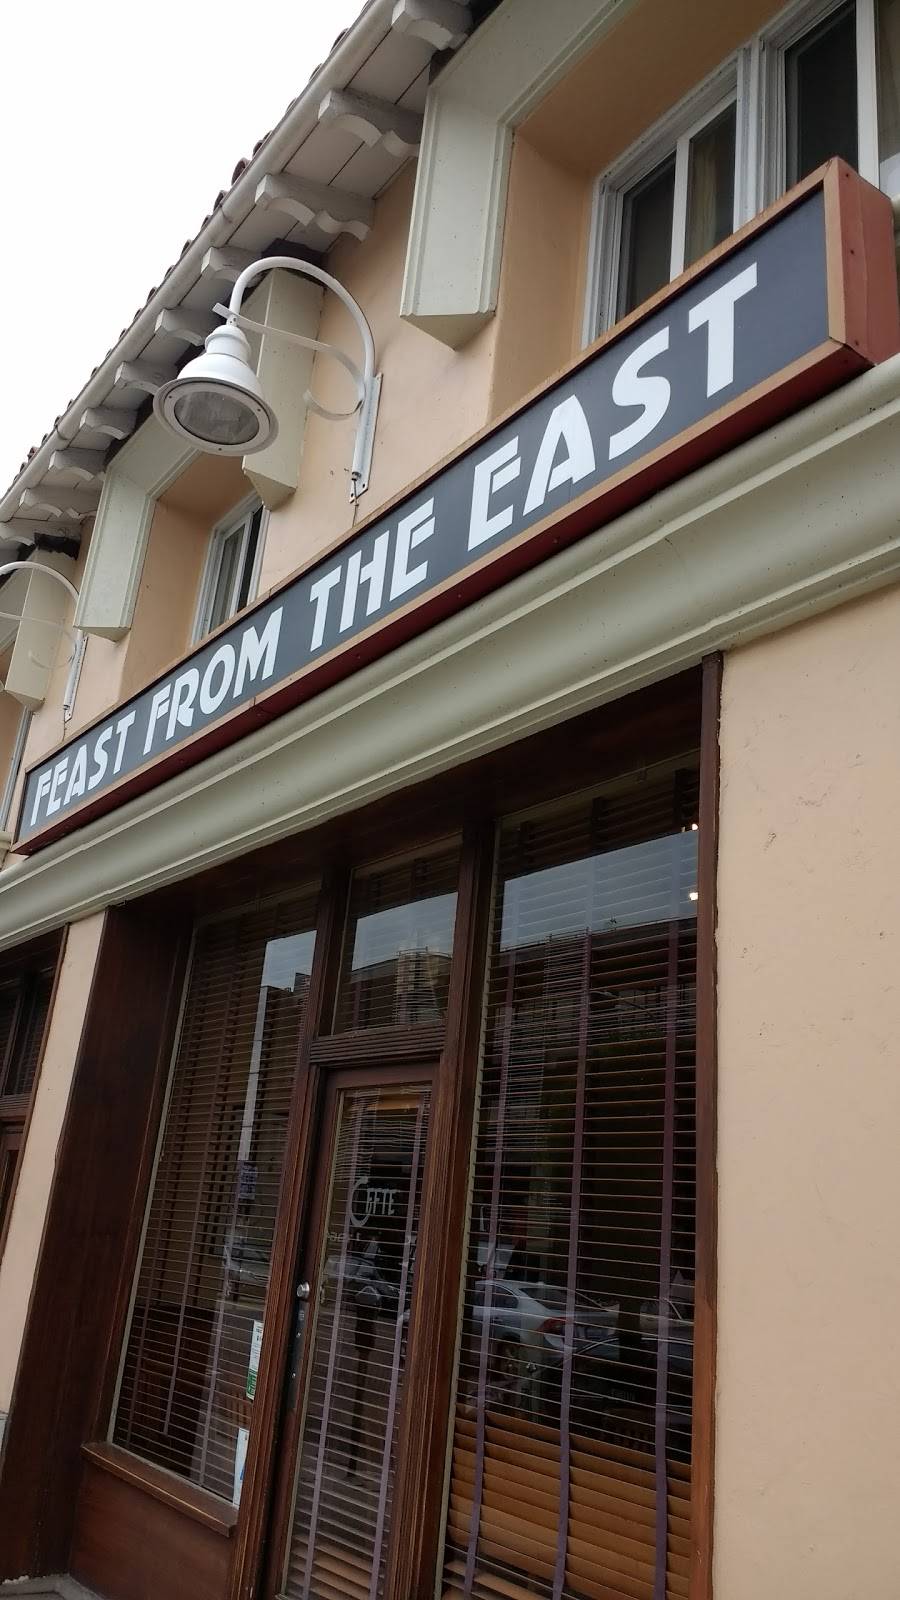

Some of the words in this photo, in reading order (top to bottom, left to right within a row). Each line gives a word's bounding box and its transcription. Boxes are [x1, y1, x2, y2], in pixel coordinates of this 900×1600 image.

[30, 711, 136, 827] FEAST
[142, 605, 284, 757] FROM
[309, 498, 436, 654] THE
[466, 262, 759, 553] EAST
